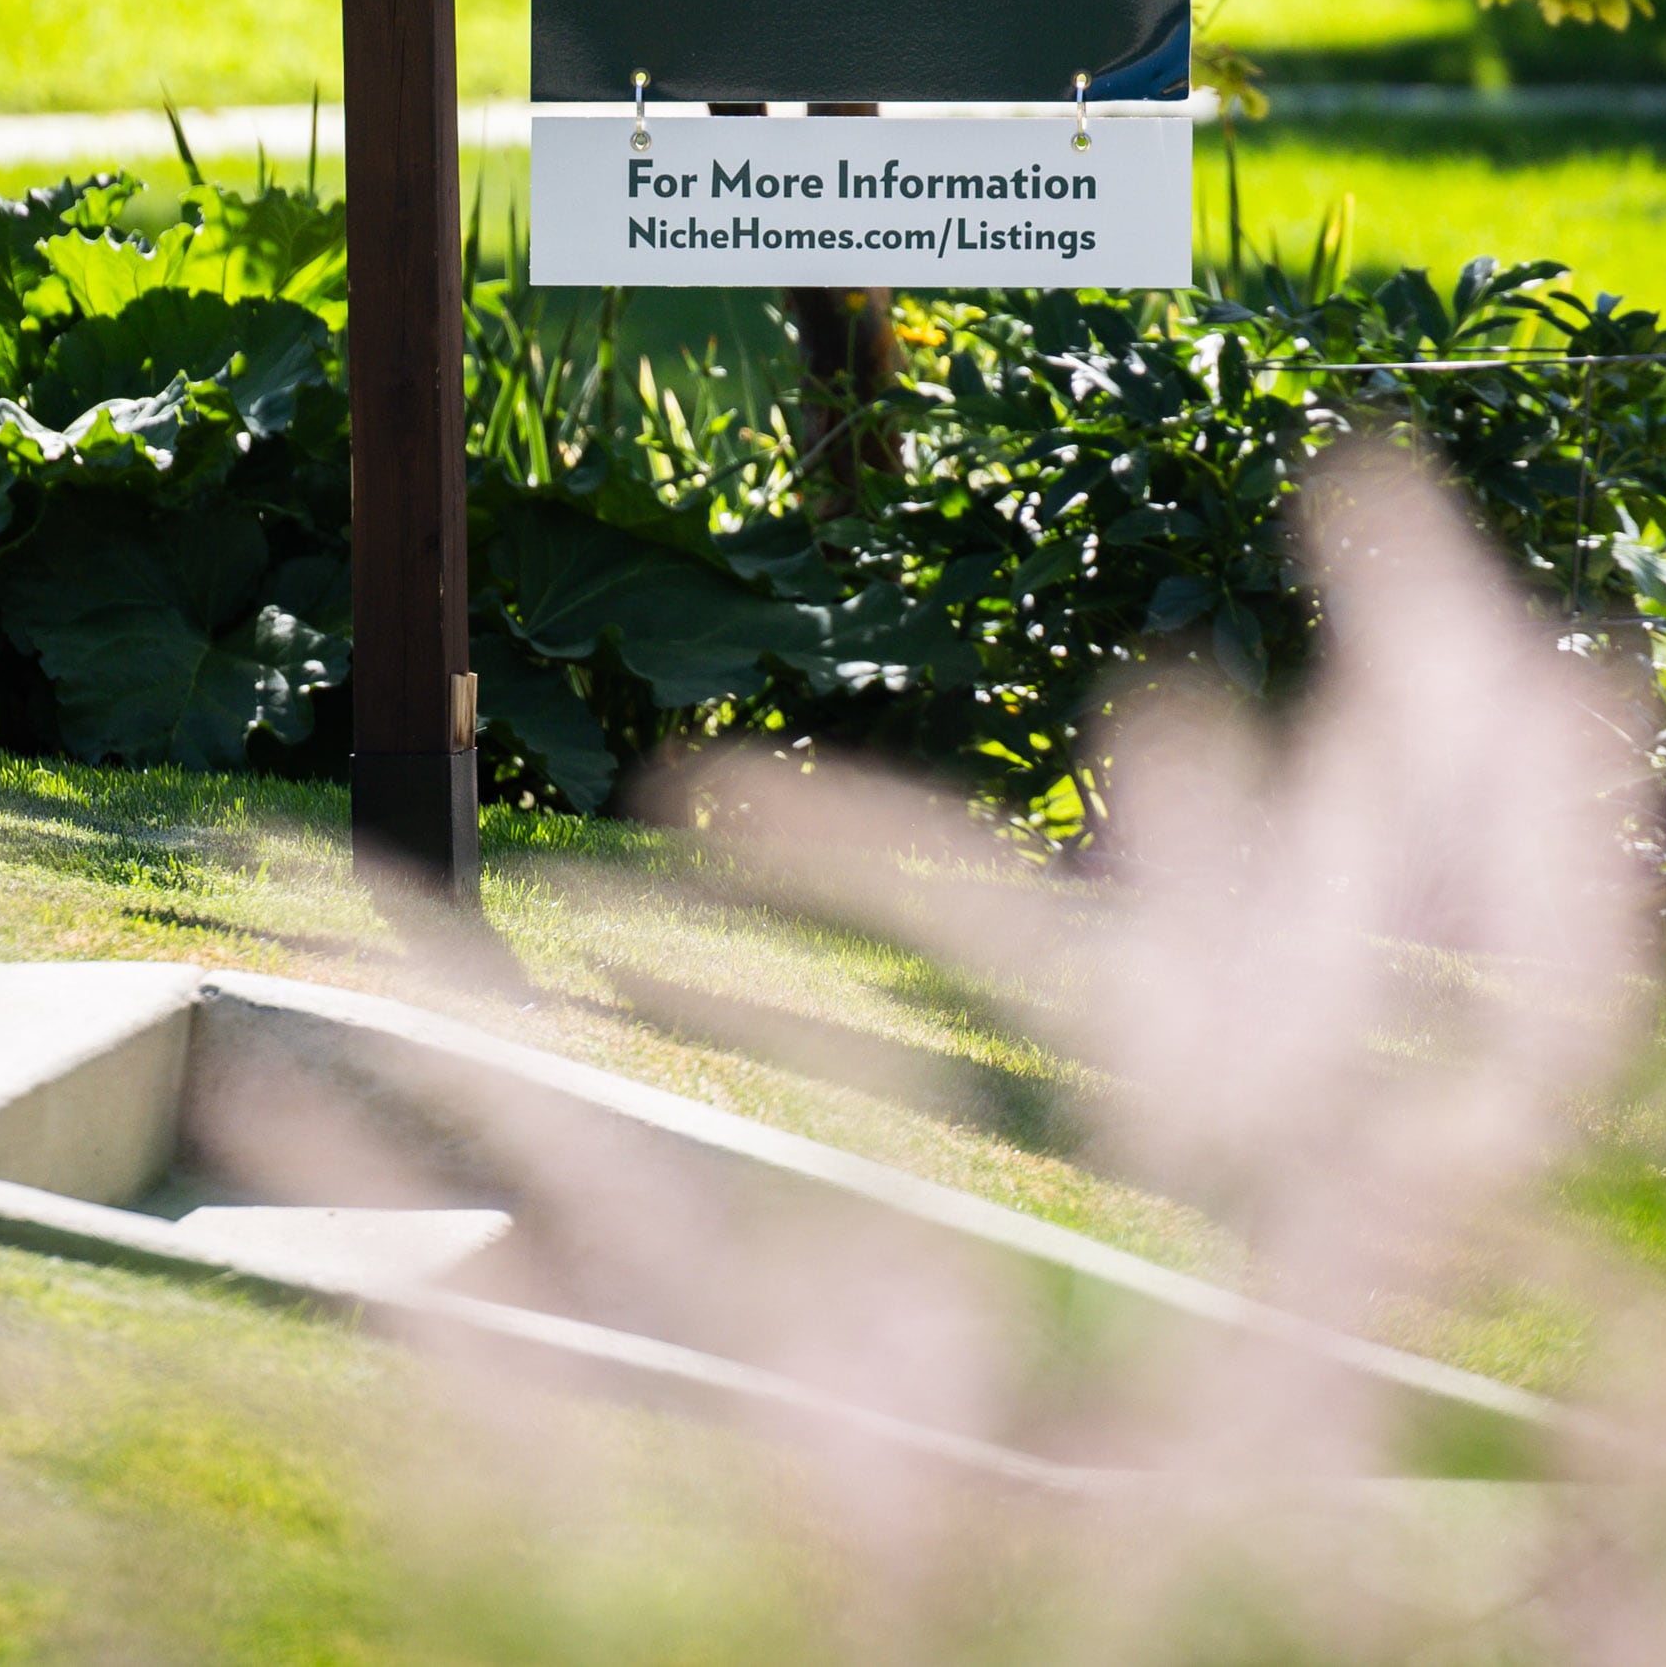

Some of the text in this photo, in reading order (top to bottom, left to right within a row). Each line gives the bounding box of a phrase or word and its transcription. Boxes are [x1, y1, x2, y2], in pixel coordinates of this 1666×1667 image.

[629, 159, 1096, 199] For More Information
[629, 217, 1095, 259] NicheHomes.com/Listings
